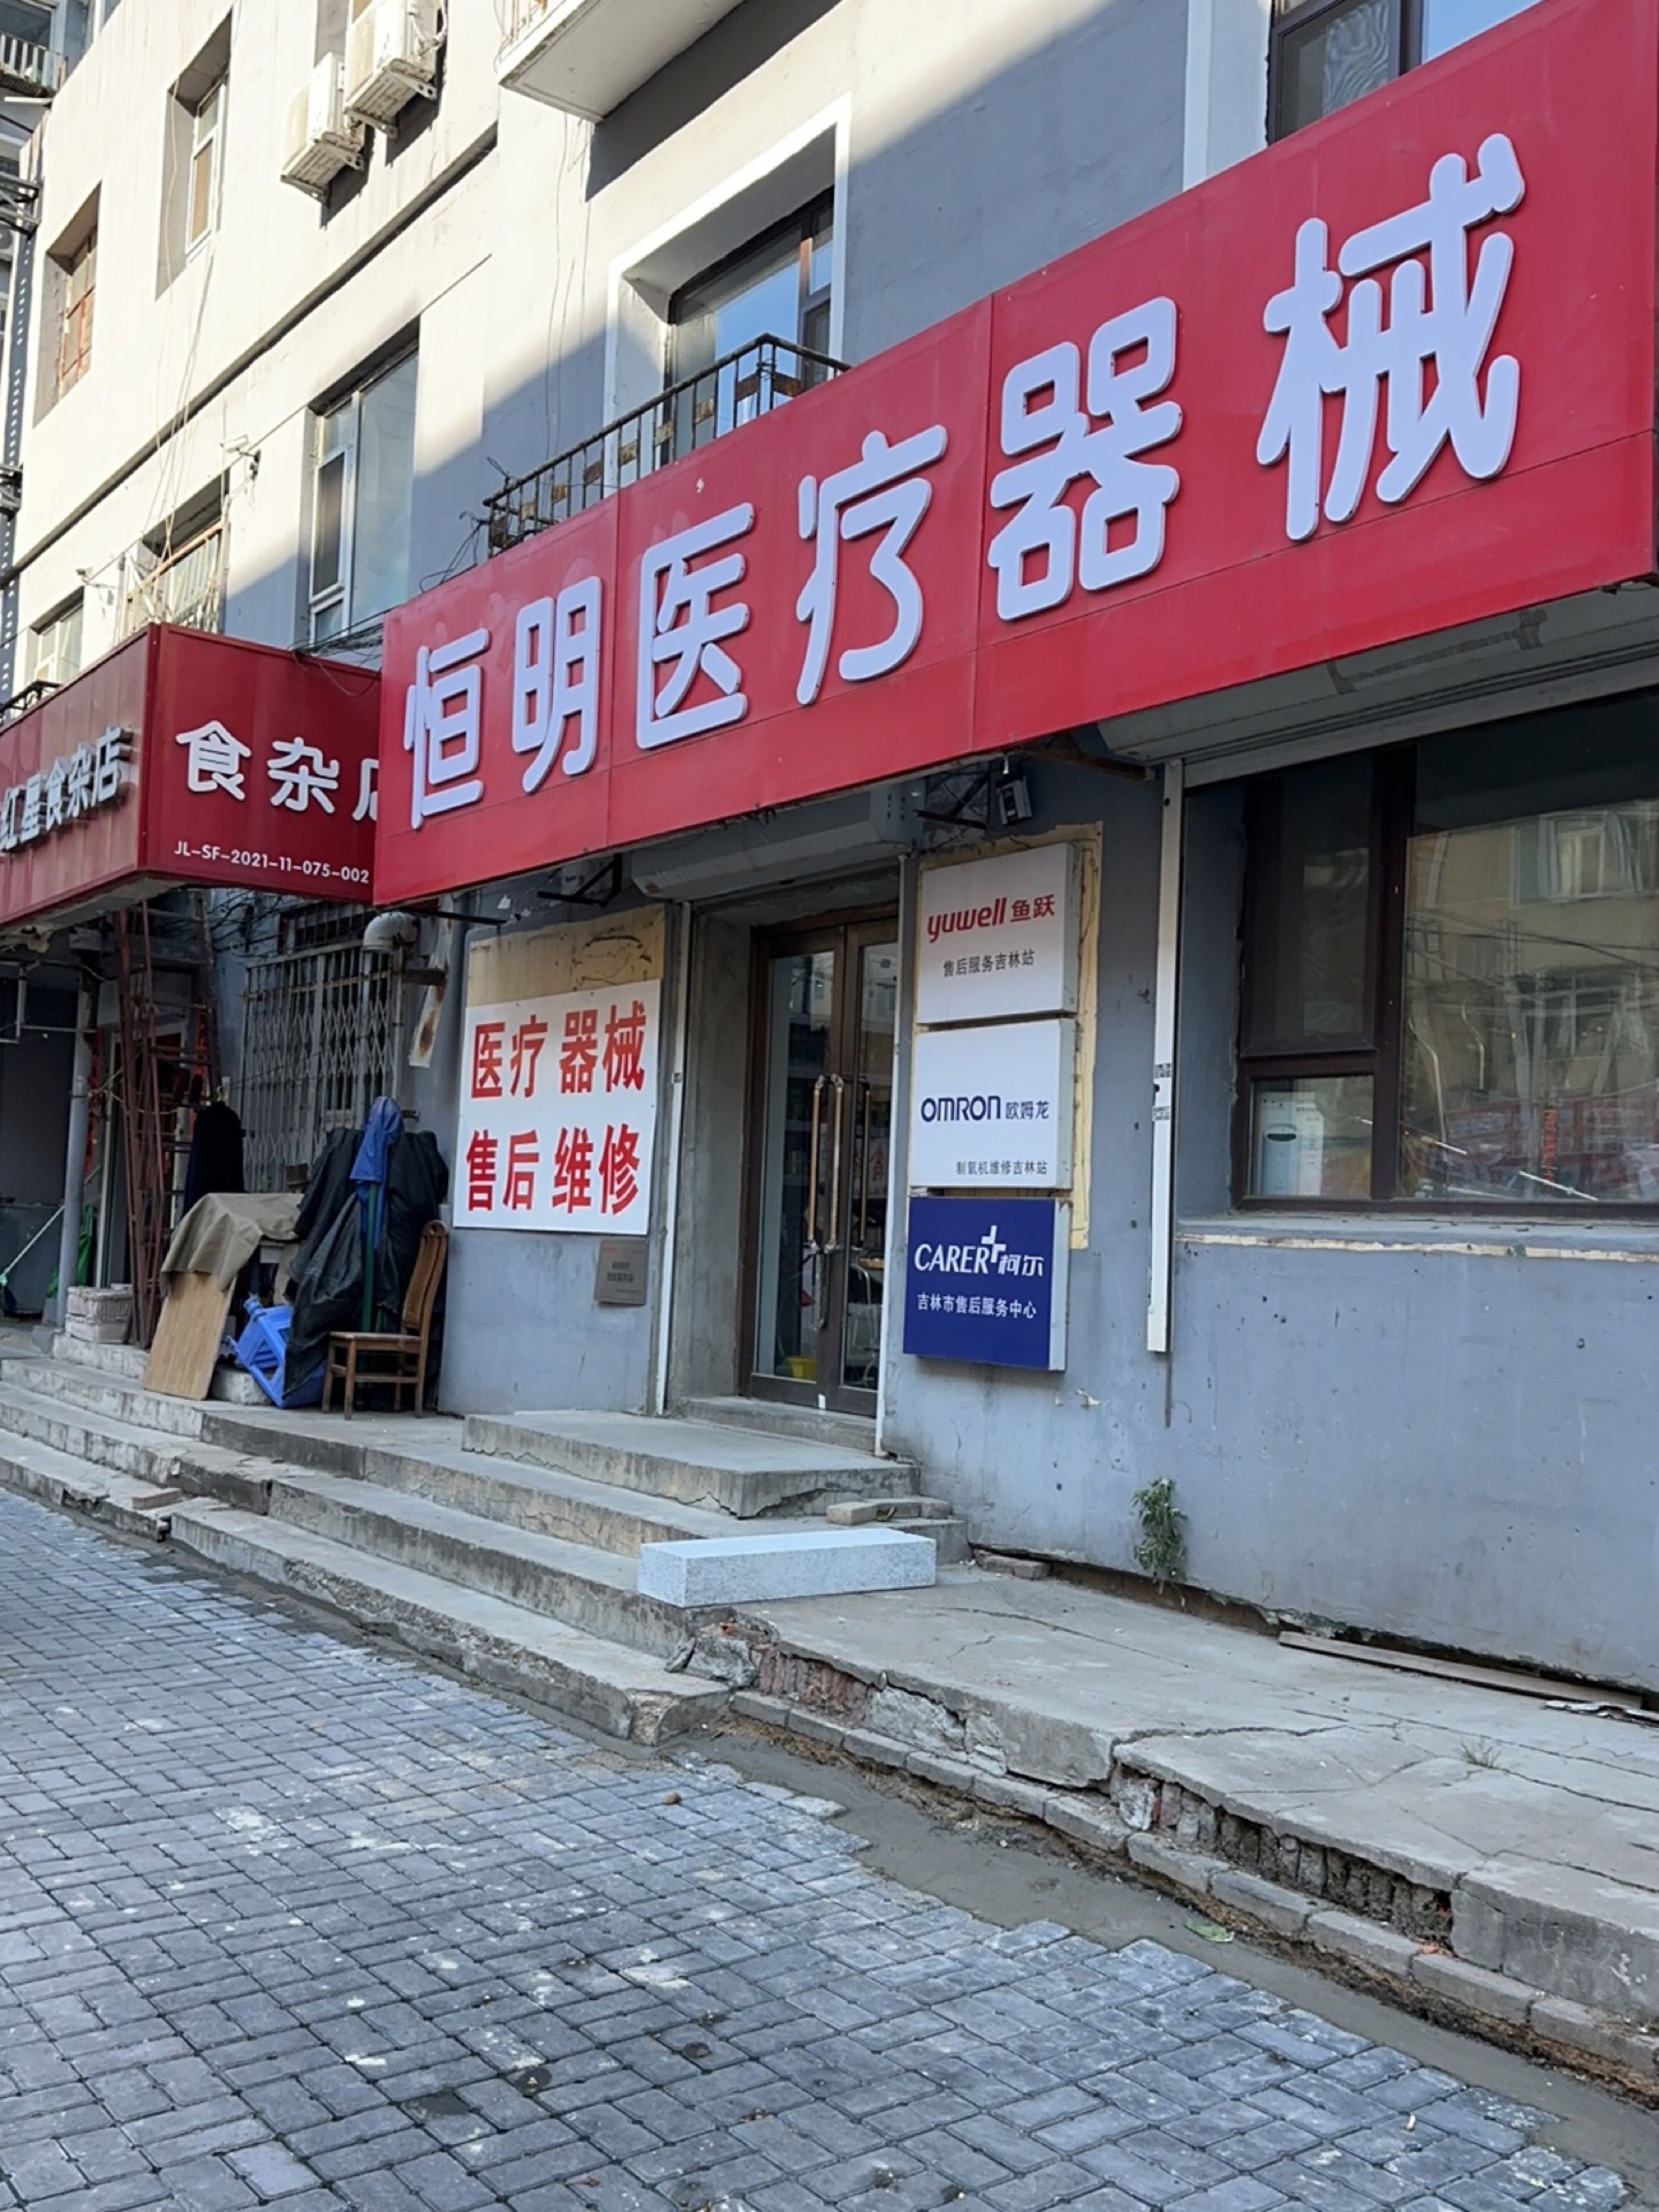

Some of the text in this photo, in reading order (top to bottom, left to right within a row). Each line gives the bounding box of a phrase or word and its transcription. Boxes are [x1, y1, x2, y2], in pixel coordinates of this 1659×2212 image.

[403, 132, 1525, 830] 恒明医疗器械
[174, 840, 370, 885] JL-SF-2021-11-075-002
[927, 894, 1055, 944] yuwell 鱼跃
[943, 948, 1036, 978] 售后服务吉林站
[471, 1000, 647, 1099] 医疗器械
[1005, 1100, 1050, 1120] 欧姆龙
[466, 1123, 641, 1215] 售后维修
[956, 1160, 1048, 1176] 制氧机维修吉林站
[914, 1243, 1045, 1277] CARER 柯尔
[917, 1291, 1038, 1320] 吉林市售后服务中心
